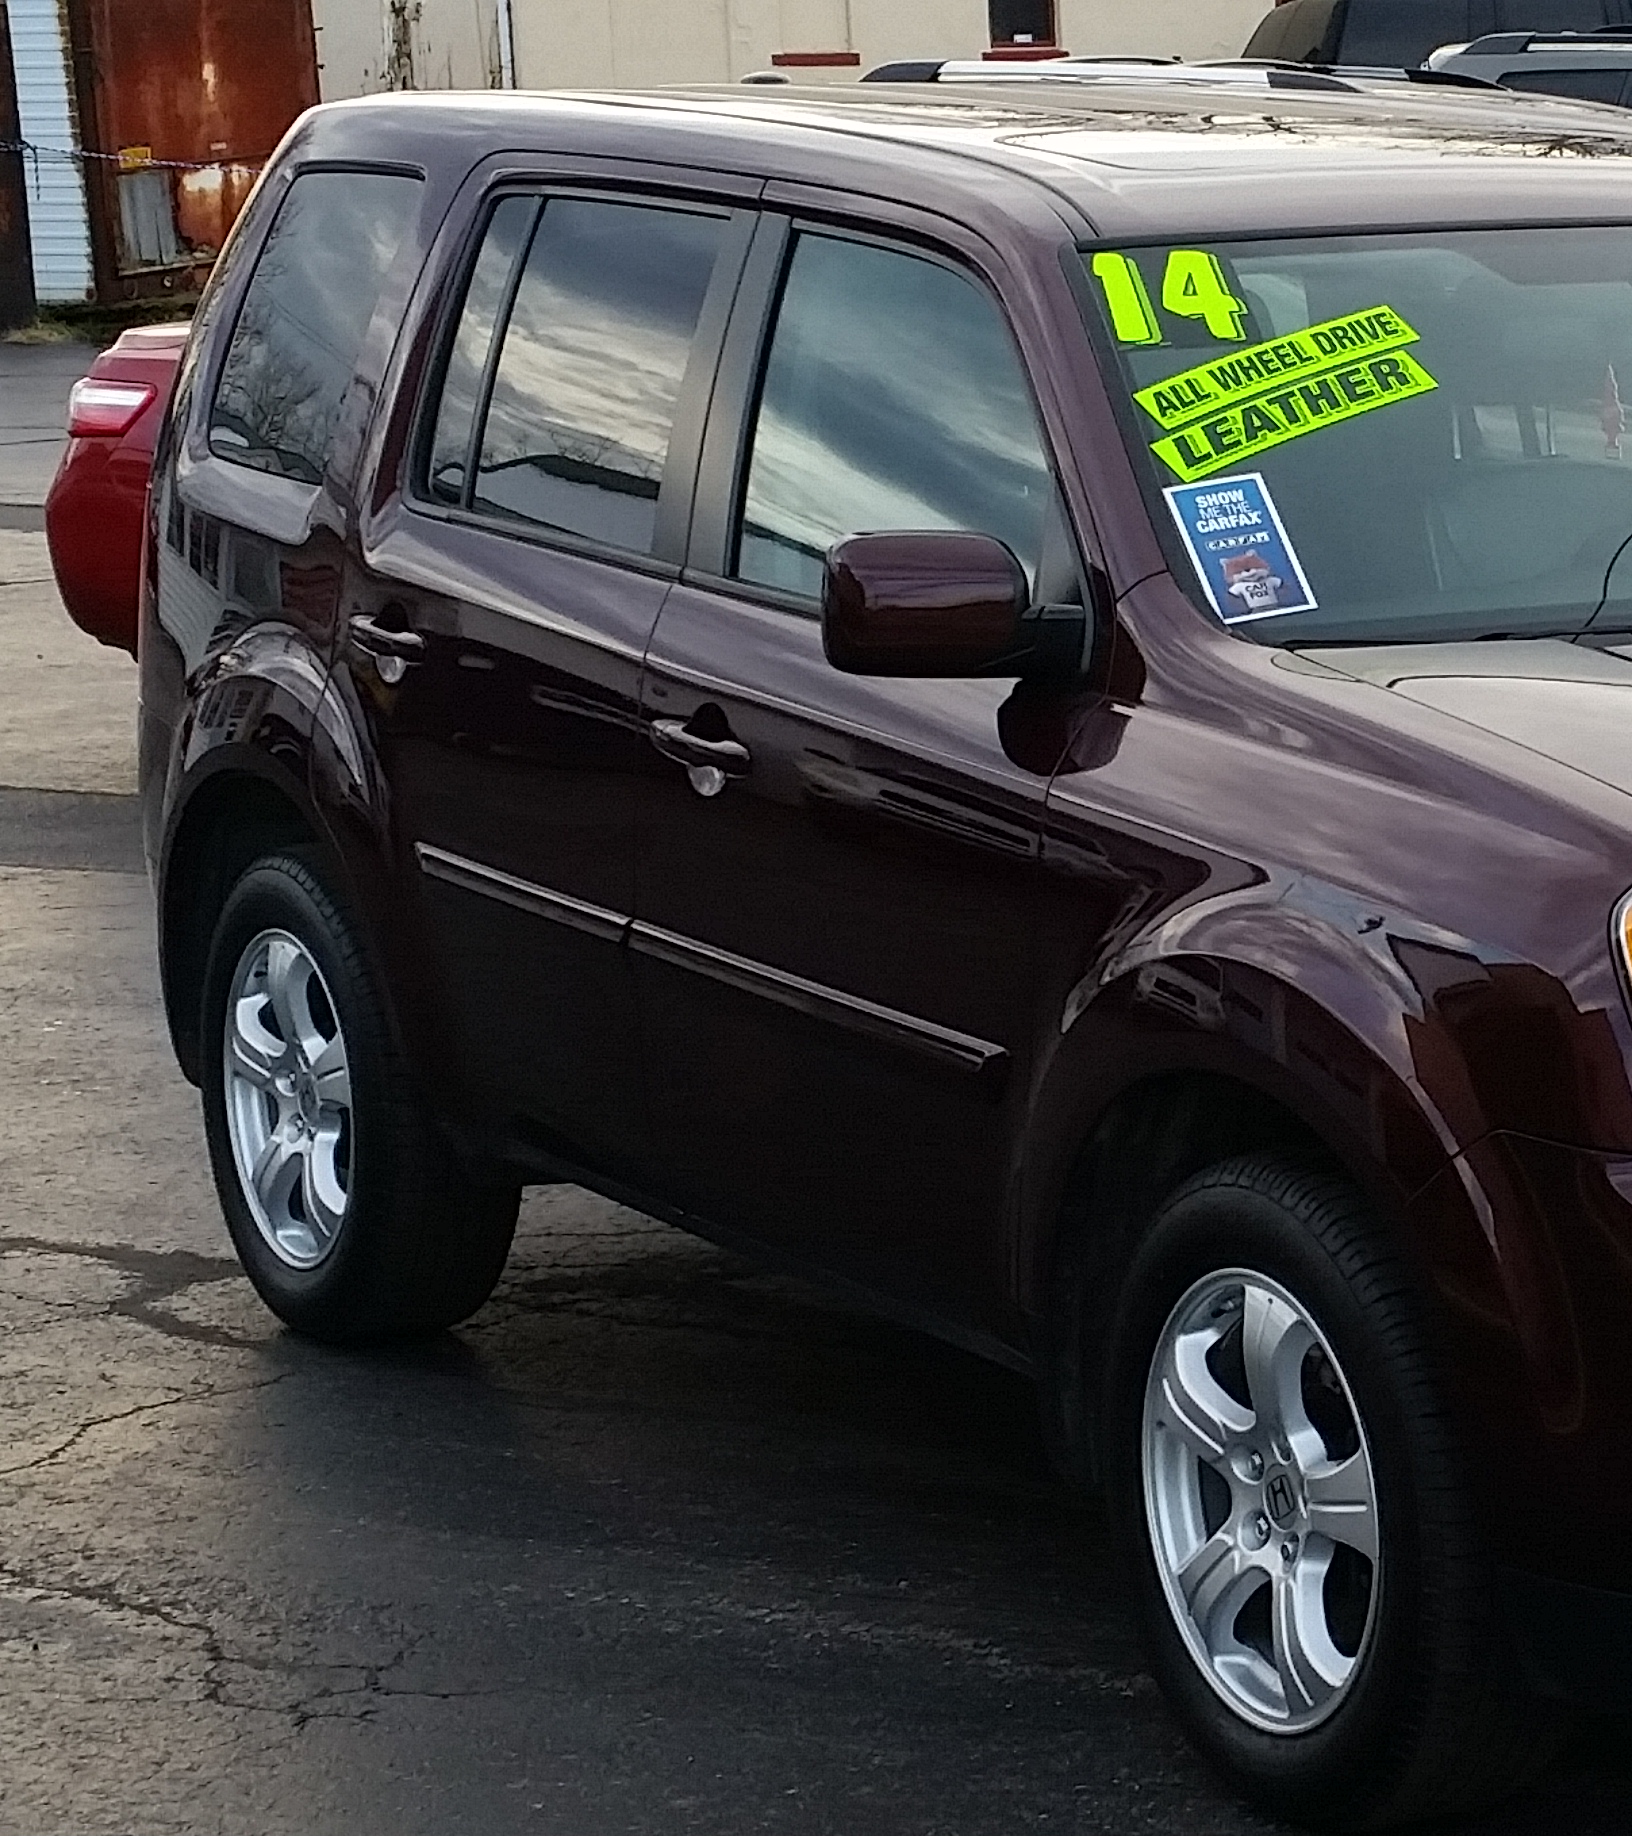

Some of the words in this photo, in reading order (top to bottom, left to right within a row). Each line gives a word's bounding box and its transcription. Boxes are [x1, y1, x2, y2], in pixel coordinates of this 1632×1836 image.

[1092, 250, 1247, 344] 14
[1153, 377, 1213, 418] ALL
[1206, 340, 1316, 392] WHEEL
[1309, 311, 1401, 356] DRIVE
[1172, 357, 1413, 470] LEATHER
[1195, 488, 1245, 508] SHOW
[1196, 510, 1263, 534] CARFAX
[1199, 505, 1222, 520] ME
[1222, 500, 1252, 516] THE
